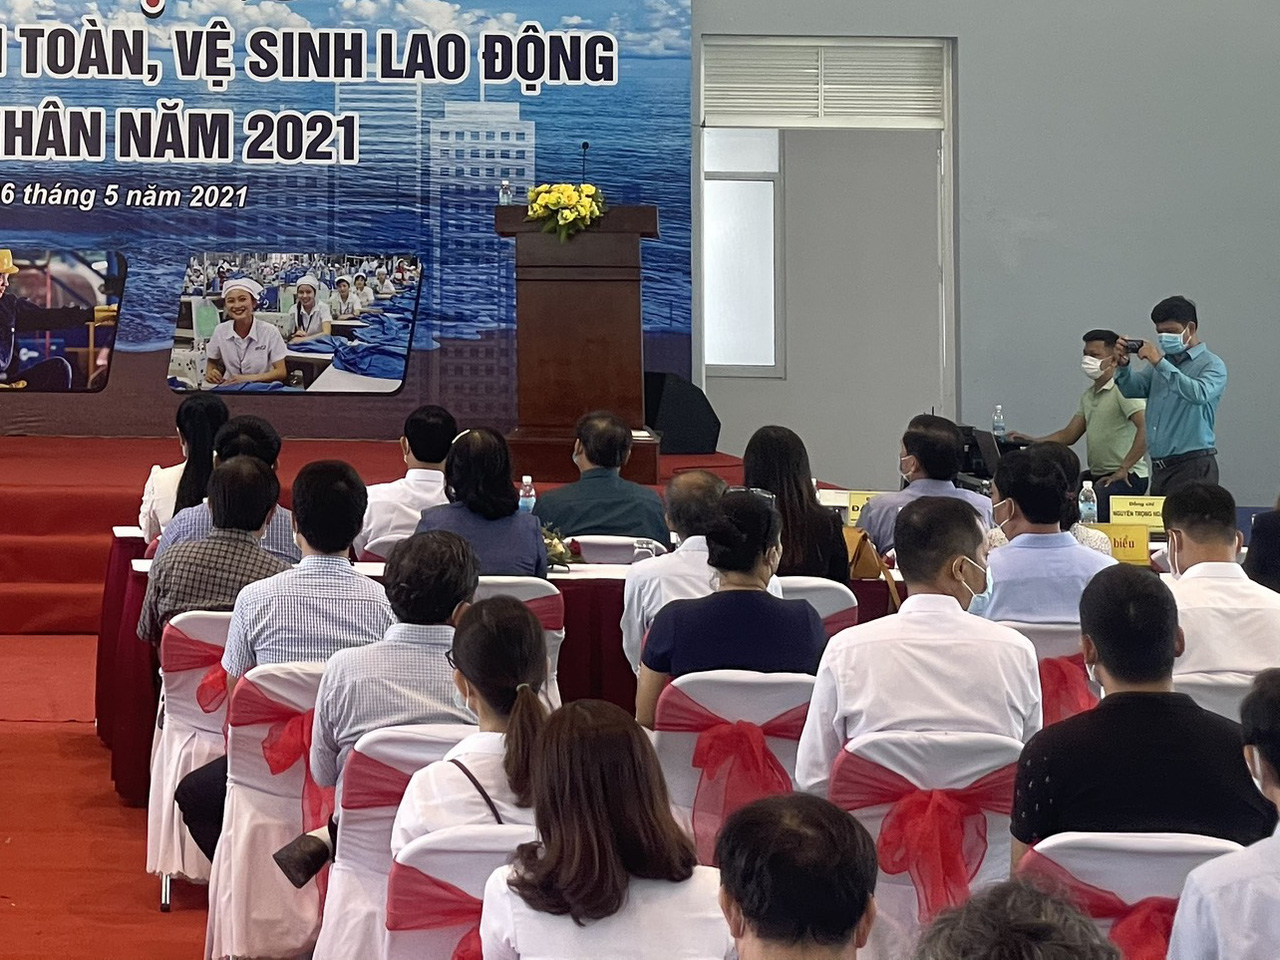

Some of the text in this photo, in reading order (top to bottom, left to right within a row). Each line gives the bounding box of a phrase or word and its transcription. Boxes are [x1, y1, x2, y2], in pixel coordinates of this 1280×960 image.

[18, 18, 159, 83] TOÀN,
[174, 20, 232, 88] VỆ
[248, 31, 363, 79] SINH
[380, 32, 467, 80] LAO
[481, 24, 615, 92] ĐỘNG
[119, 101, 230, 159] NĂM
[245, 113, 356, 162] 2021
[23, 182, 97, 211] tháng
[103, 184, 120, 206] 5
[126, 184, 182, 207] năm
[189, 185, 249, 208] 2021
[1113, 534, 1135, 548] biểu
